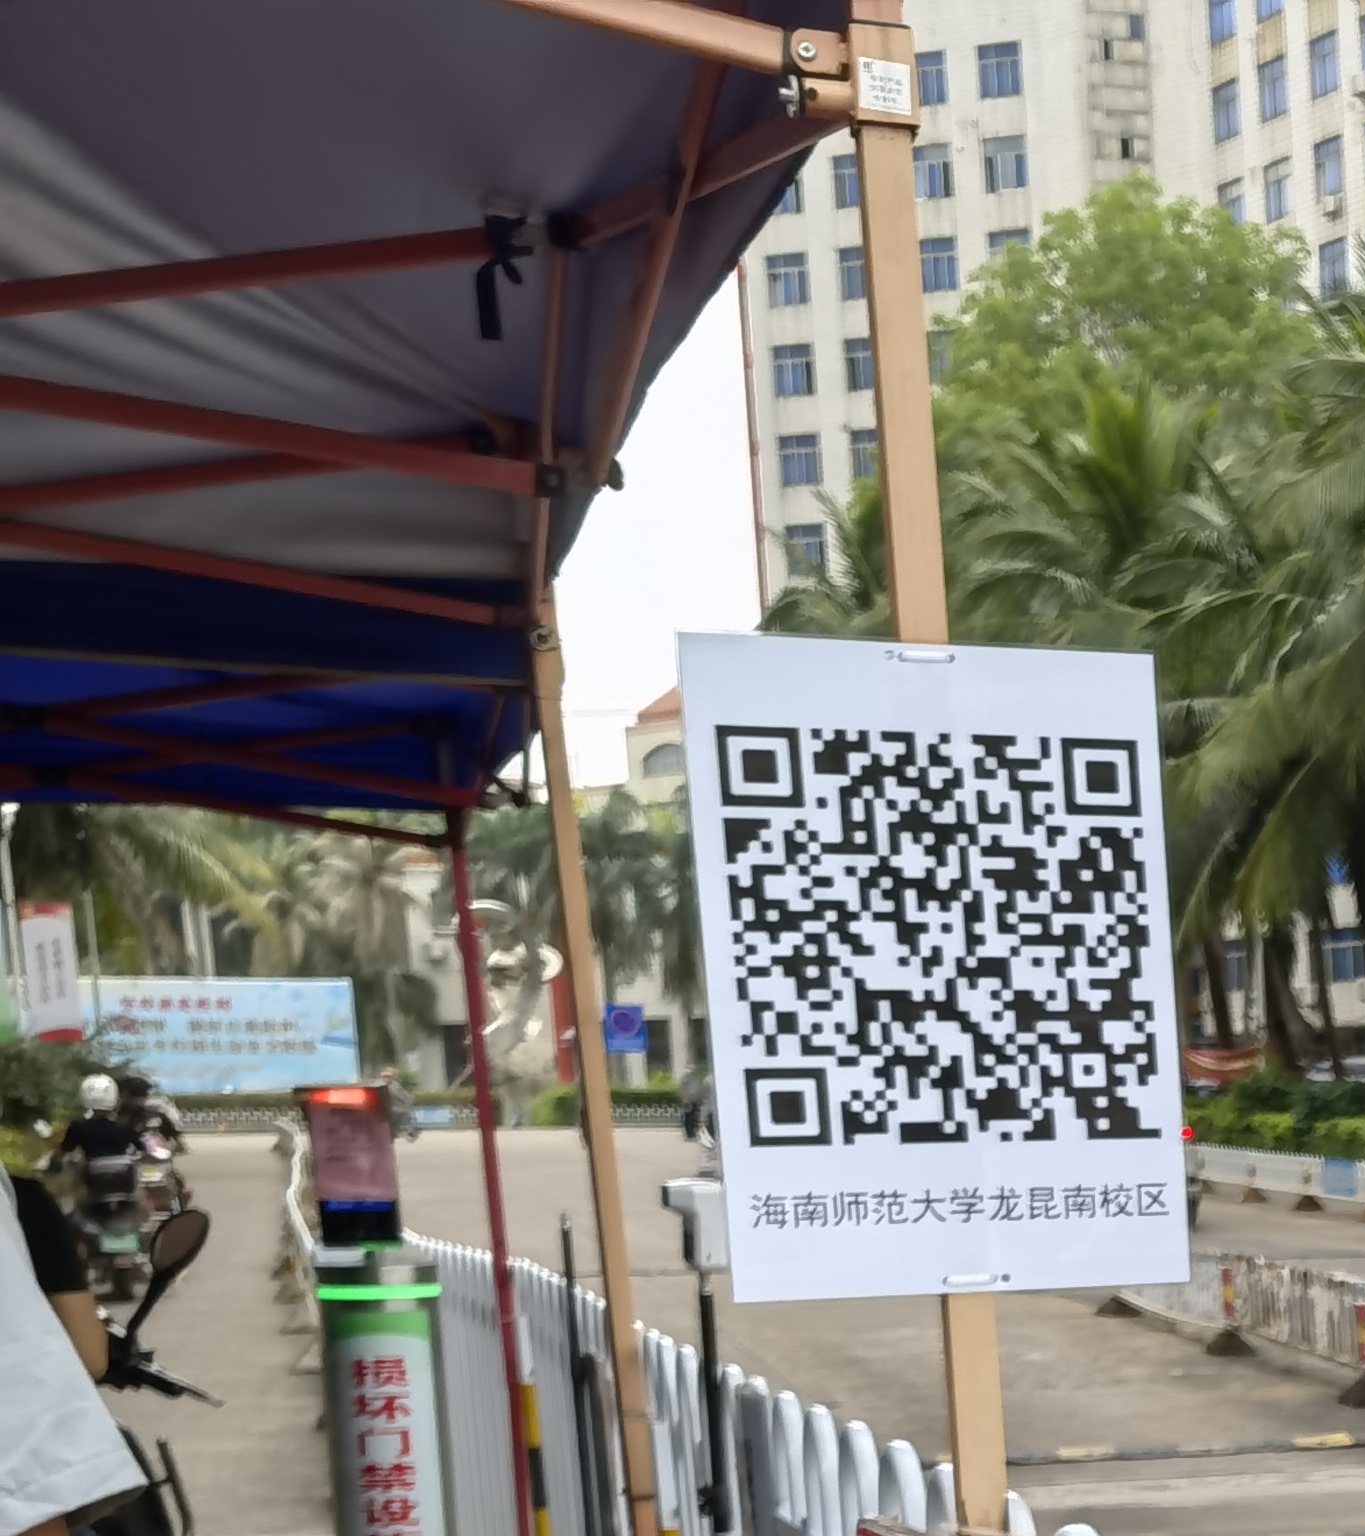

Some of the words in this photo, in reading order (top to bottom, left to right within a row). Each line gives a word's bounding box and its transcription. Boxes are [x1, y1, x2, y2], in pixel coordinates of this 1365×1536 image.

[750, 1182, 1169, 1230] 海南师范大学龙昆南校区
